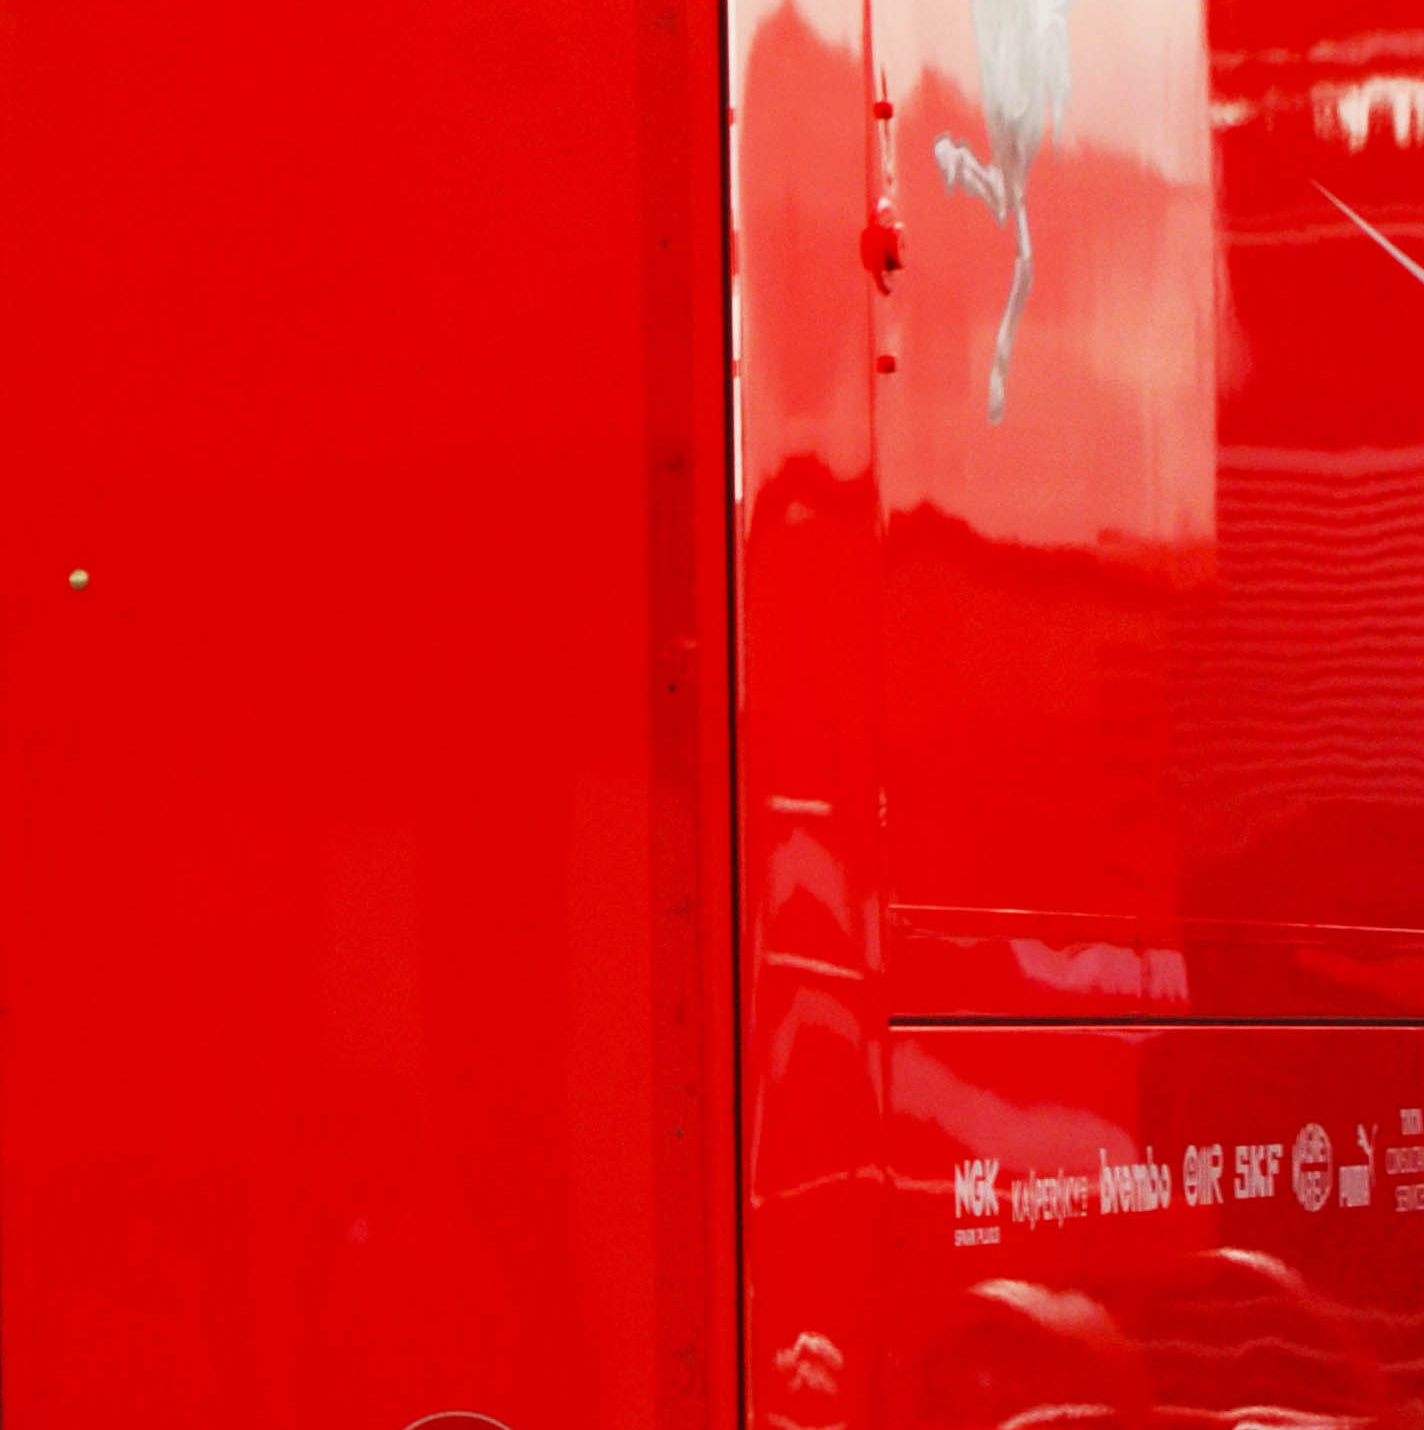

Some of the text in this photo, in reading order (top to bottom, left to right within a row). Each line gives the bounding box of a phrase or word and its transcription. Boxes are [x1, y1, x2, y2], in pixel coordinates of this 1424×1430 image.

[954, 1158, 999, 1219] NGK
[1099, 1147, 1171, 1215] brembo
[1234, 1143, 1284, 1199] SKF
